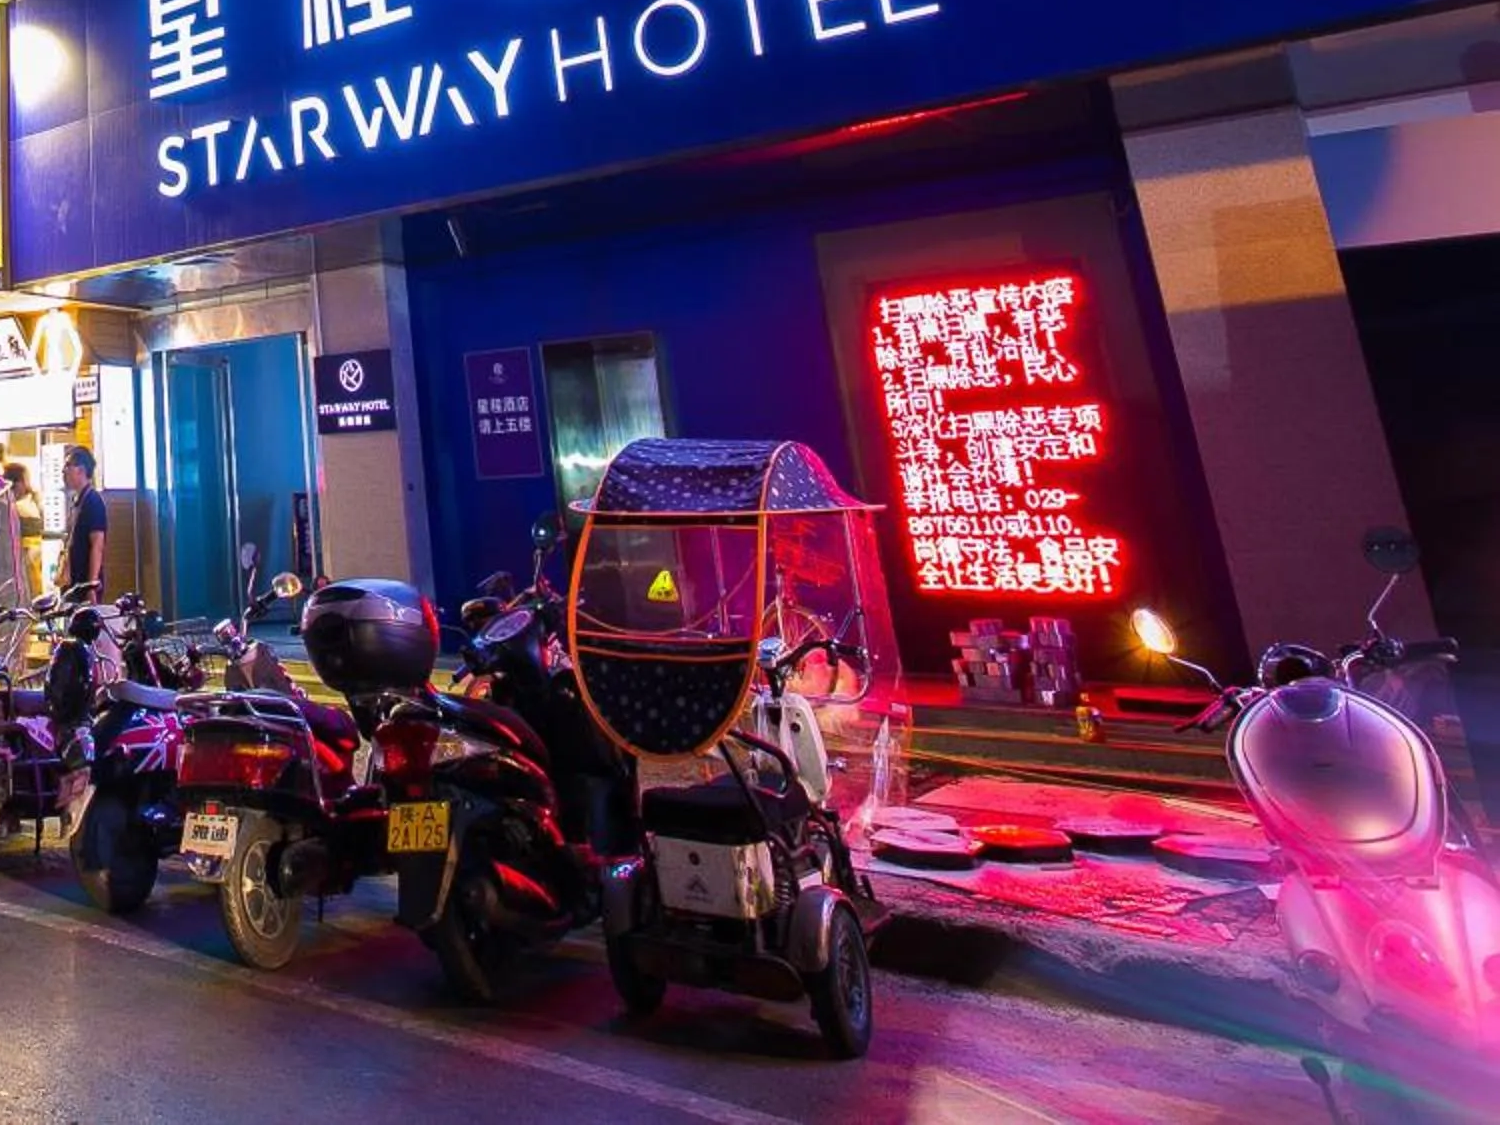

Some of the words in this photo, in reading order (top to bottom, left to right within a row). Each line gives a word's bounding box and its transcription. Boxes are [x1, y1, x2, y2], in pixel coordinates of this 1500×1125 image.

[156, 36, 523, 199] STARWAY
[879, 278, 1074, 323] 扫黑除恶宣传内容
